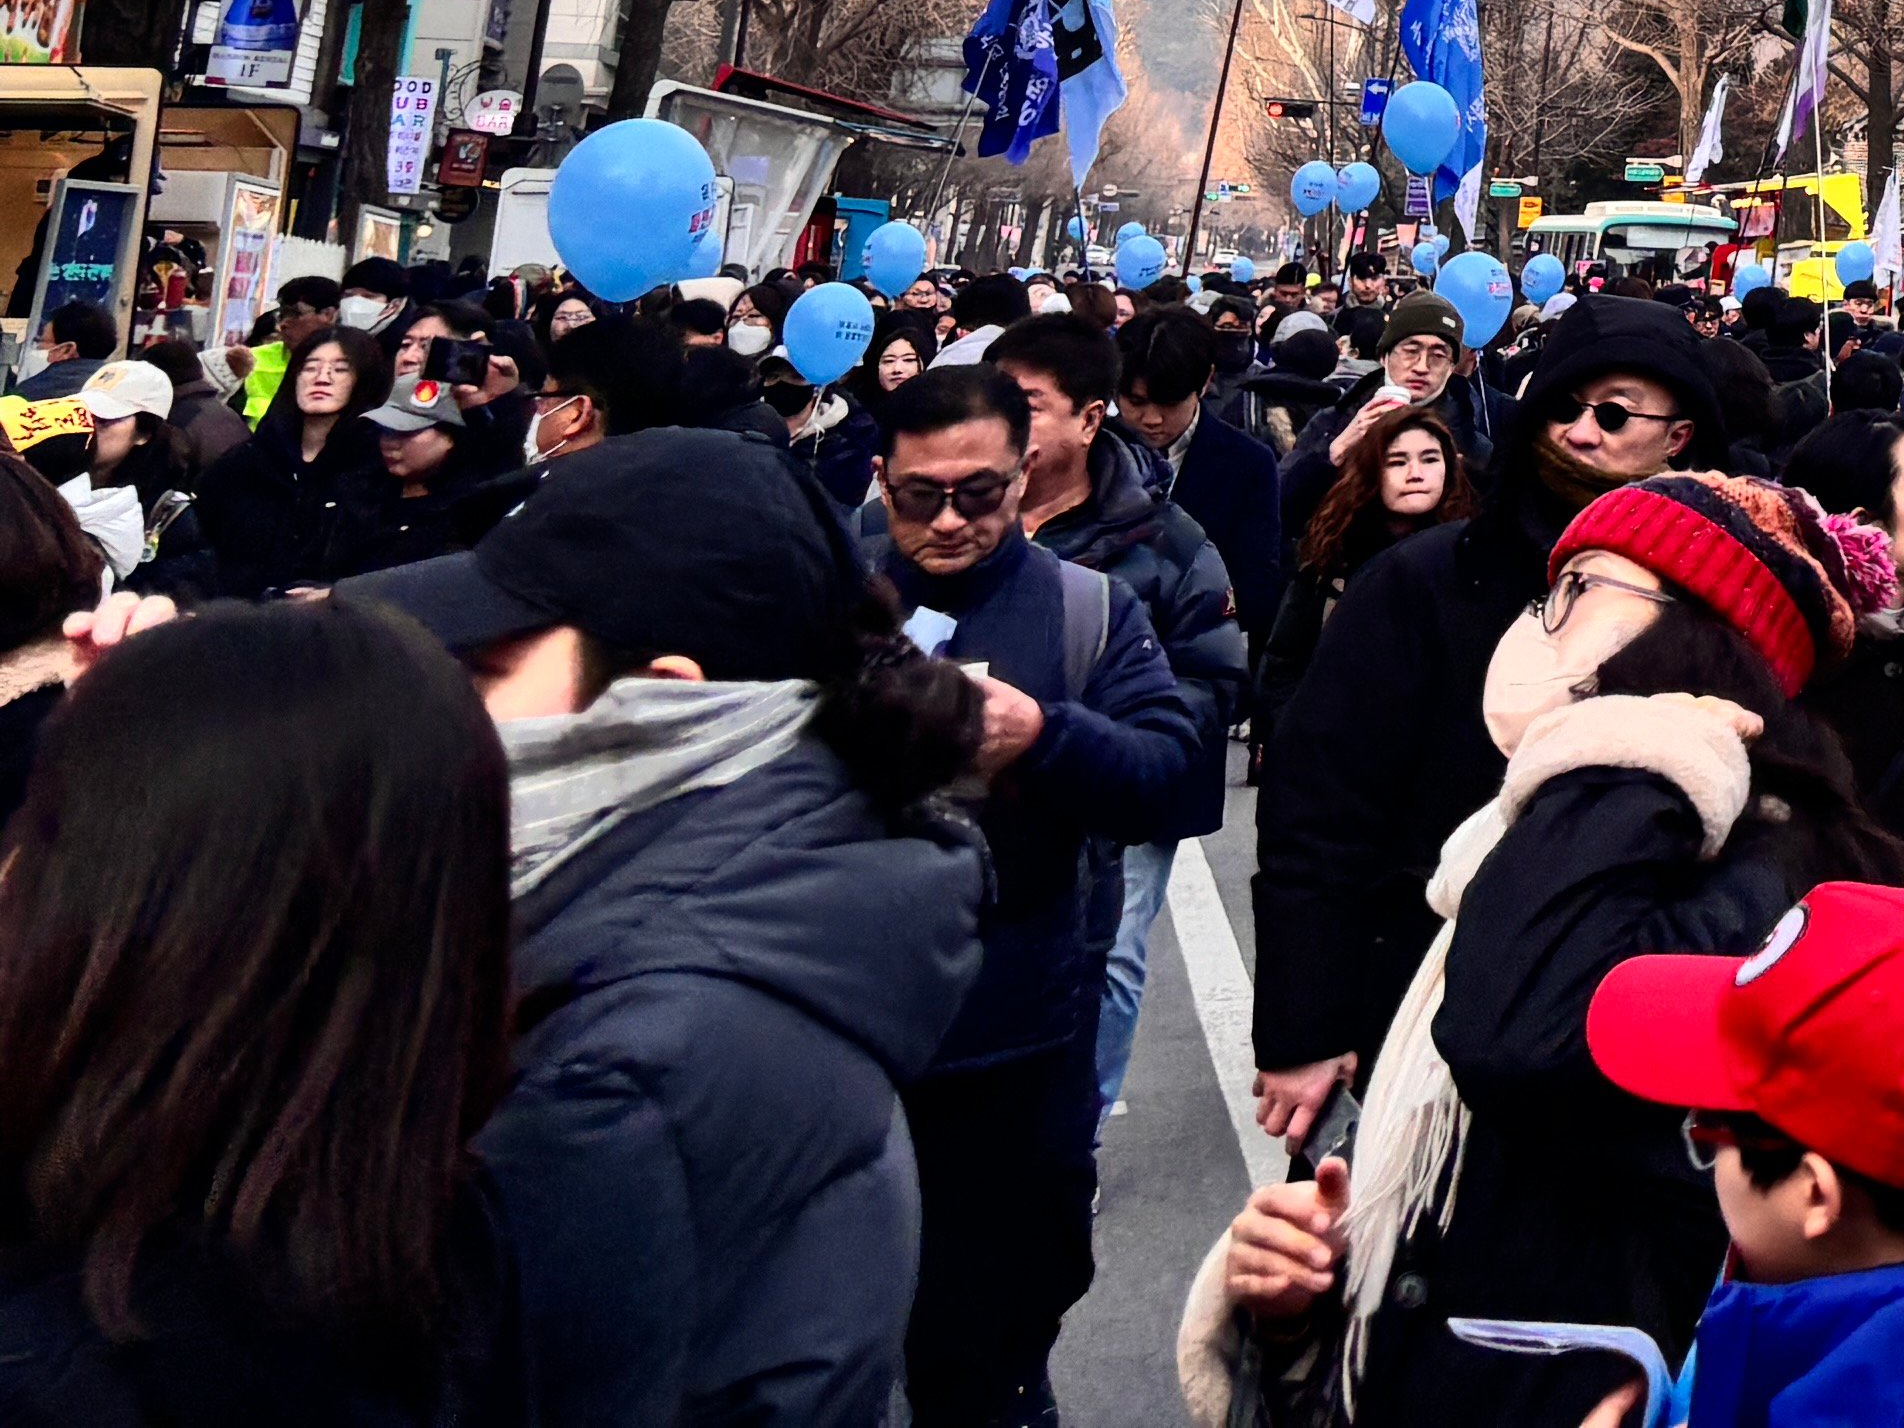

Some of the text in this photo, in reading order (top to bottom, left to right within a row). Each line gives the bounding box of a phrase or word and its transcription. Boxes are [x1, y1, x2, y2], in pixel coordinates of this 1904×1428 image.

[395, 79, 432, 94] OOD
[396, 96, 428, 110] UB
[392, 113, 426, 127] AR
